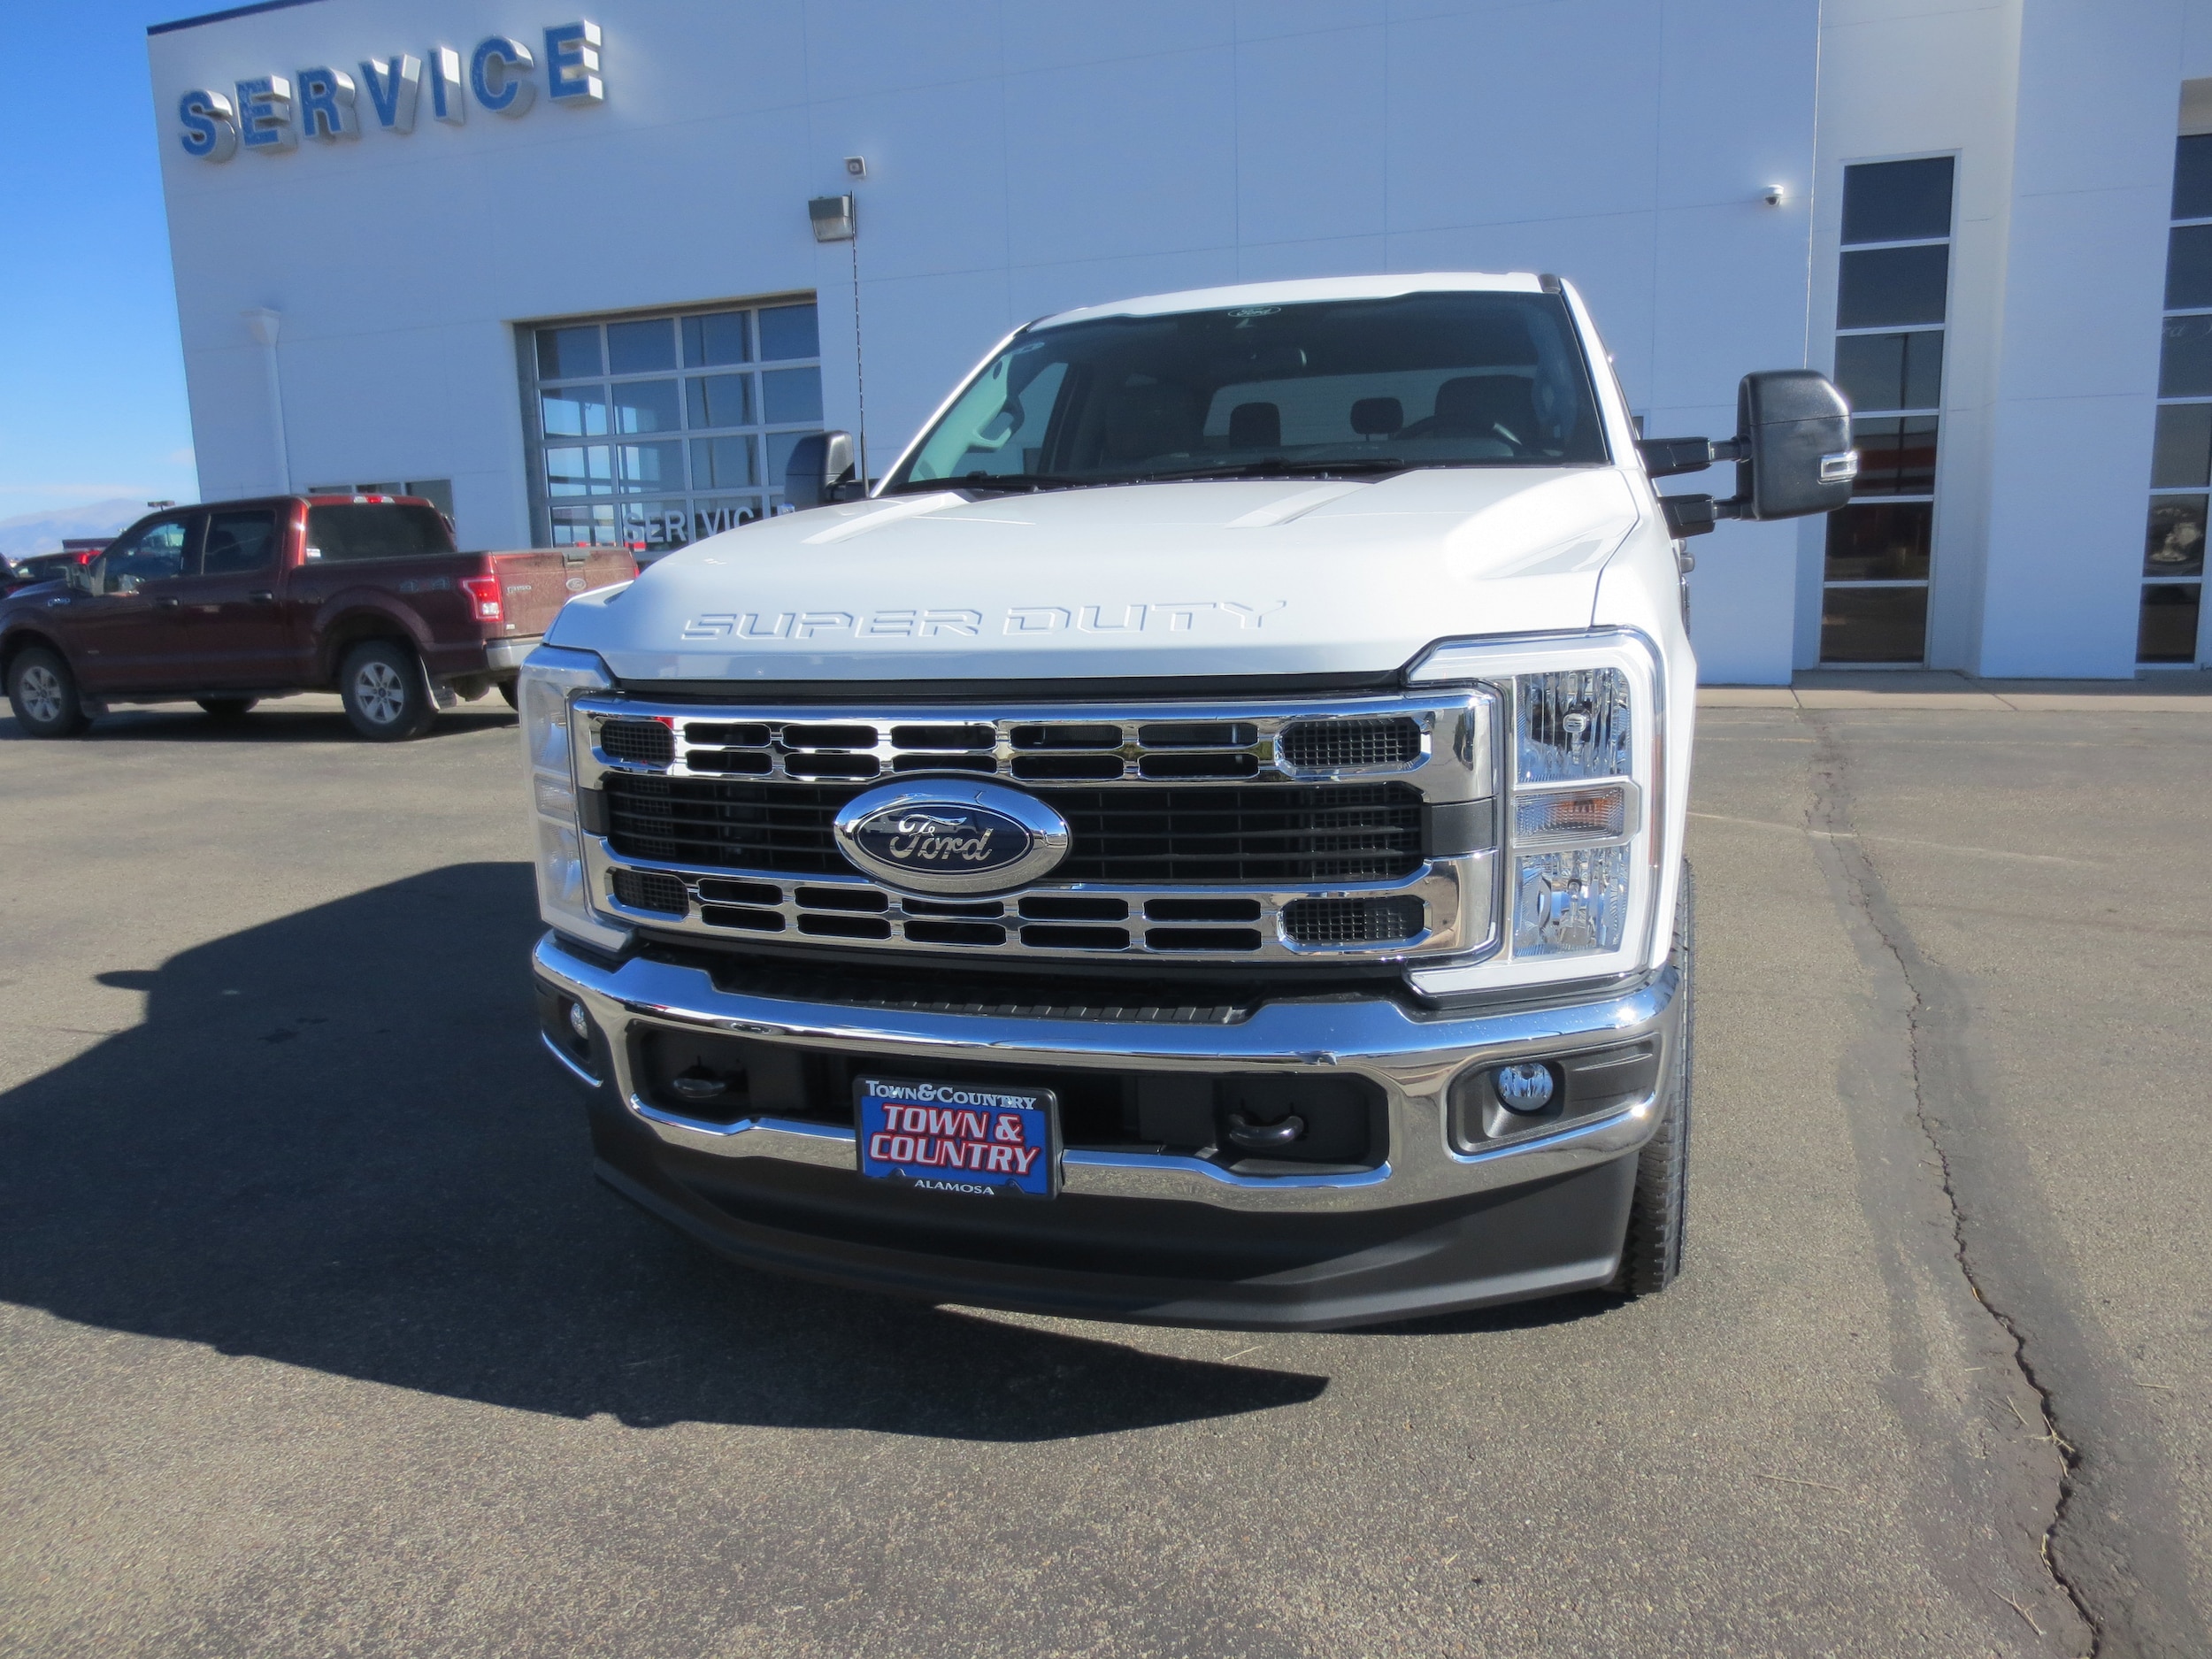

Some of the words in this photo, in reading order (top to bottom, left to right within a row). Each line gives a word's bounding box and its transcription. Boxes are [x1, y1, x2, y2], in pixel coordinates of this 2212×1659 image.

[180, 19, 603, 163] SERVICE
[680, 609, 981, 640] SUPER
[1002, 600, 1287, 635] DUTY
[889, 813, 993, 862] Ford
[882, 1103, 989, 1141] TOWN
[993, 1112, 1025, 1144] &
[869, 1132, 1041, 1176] COUNTRY
[914, 1179, 995, 1195] ALAMOSA
